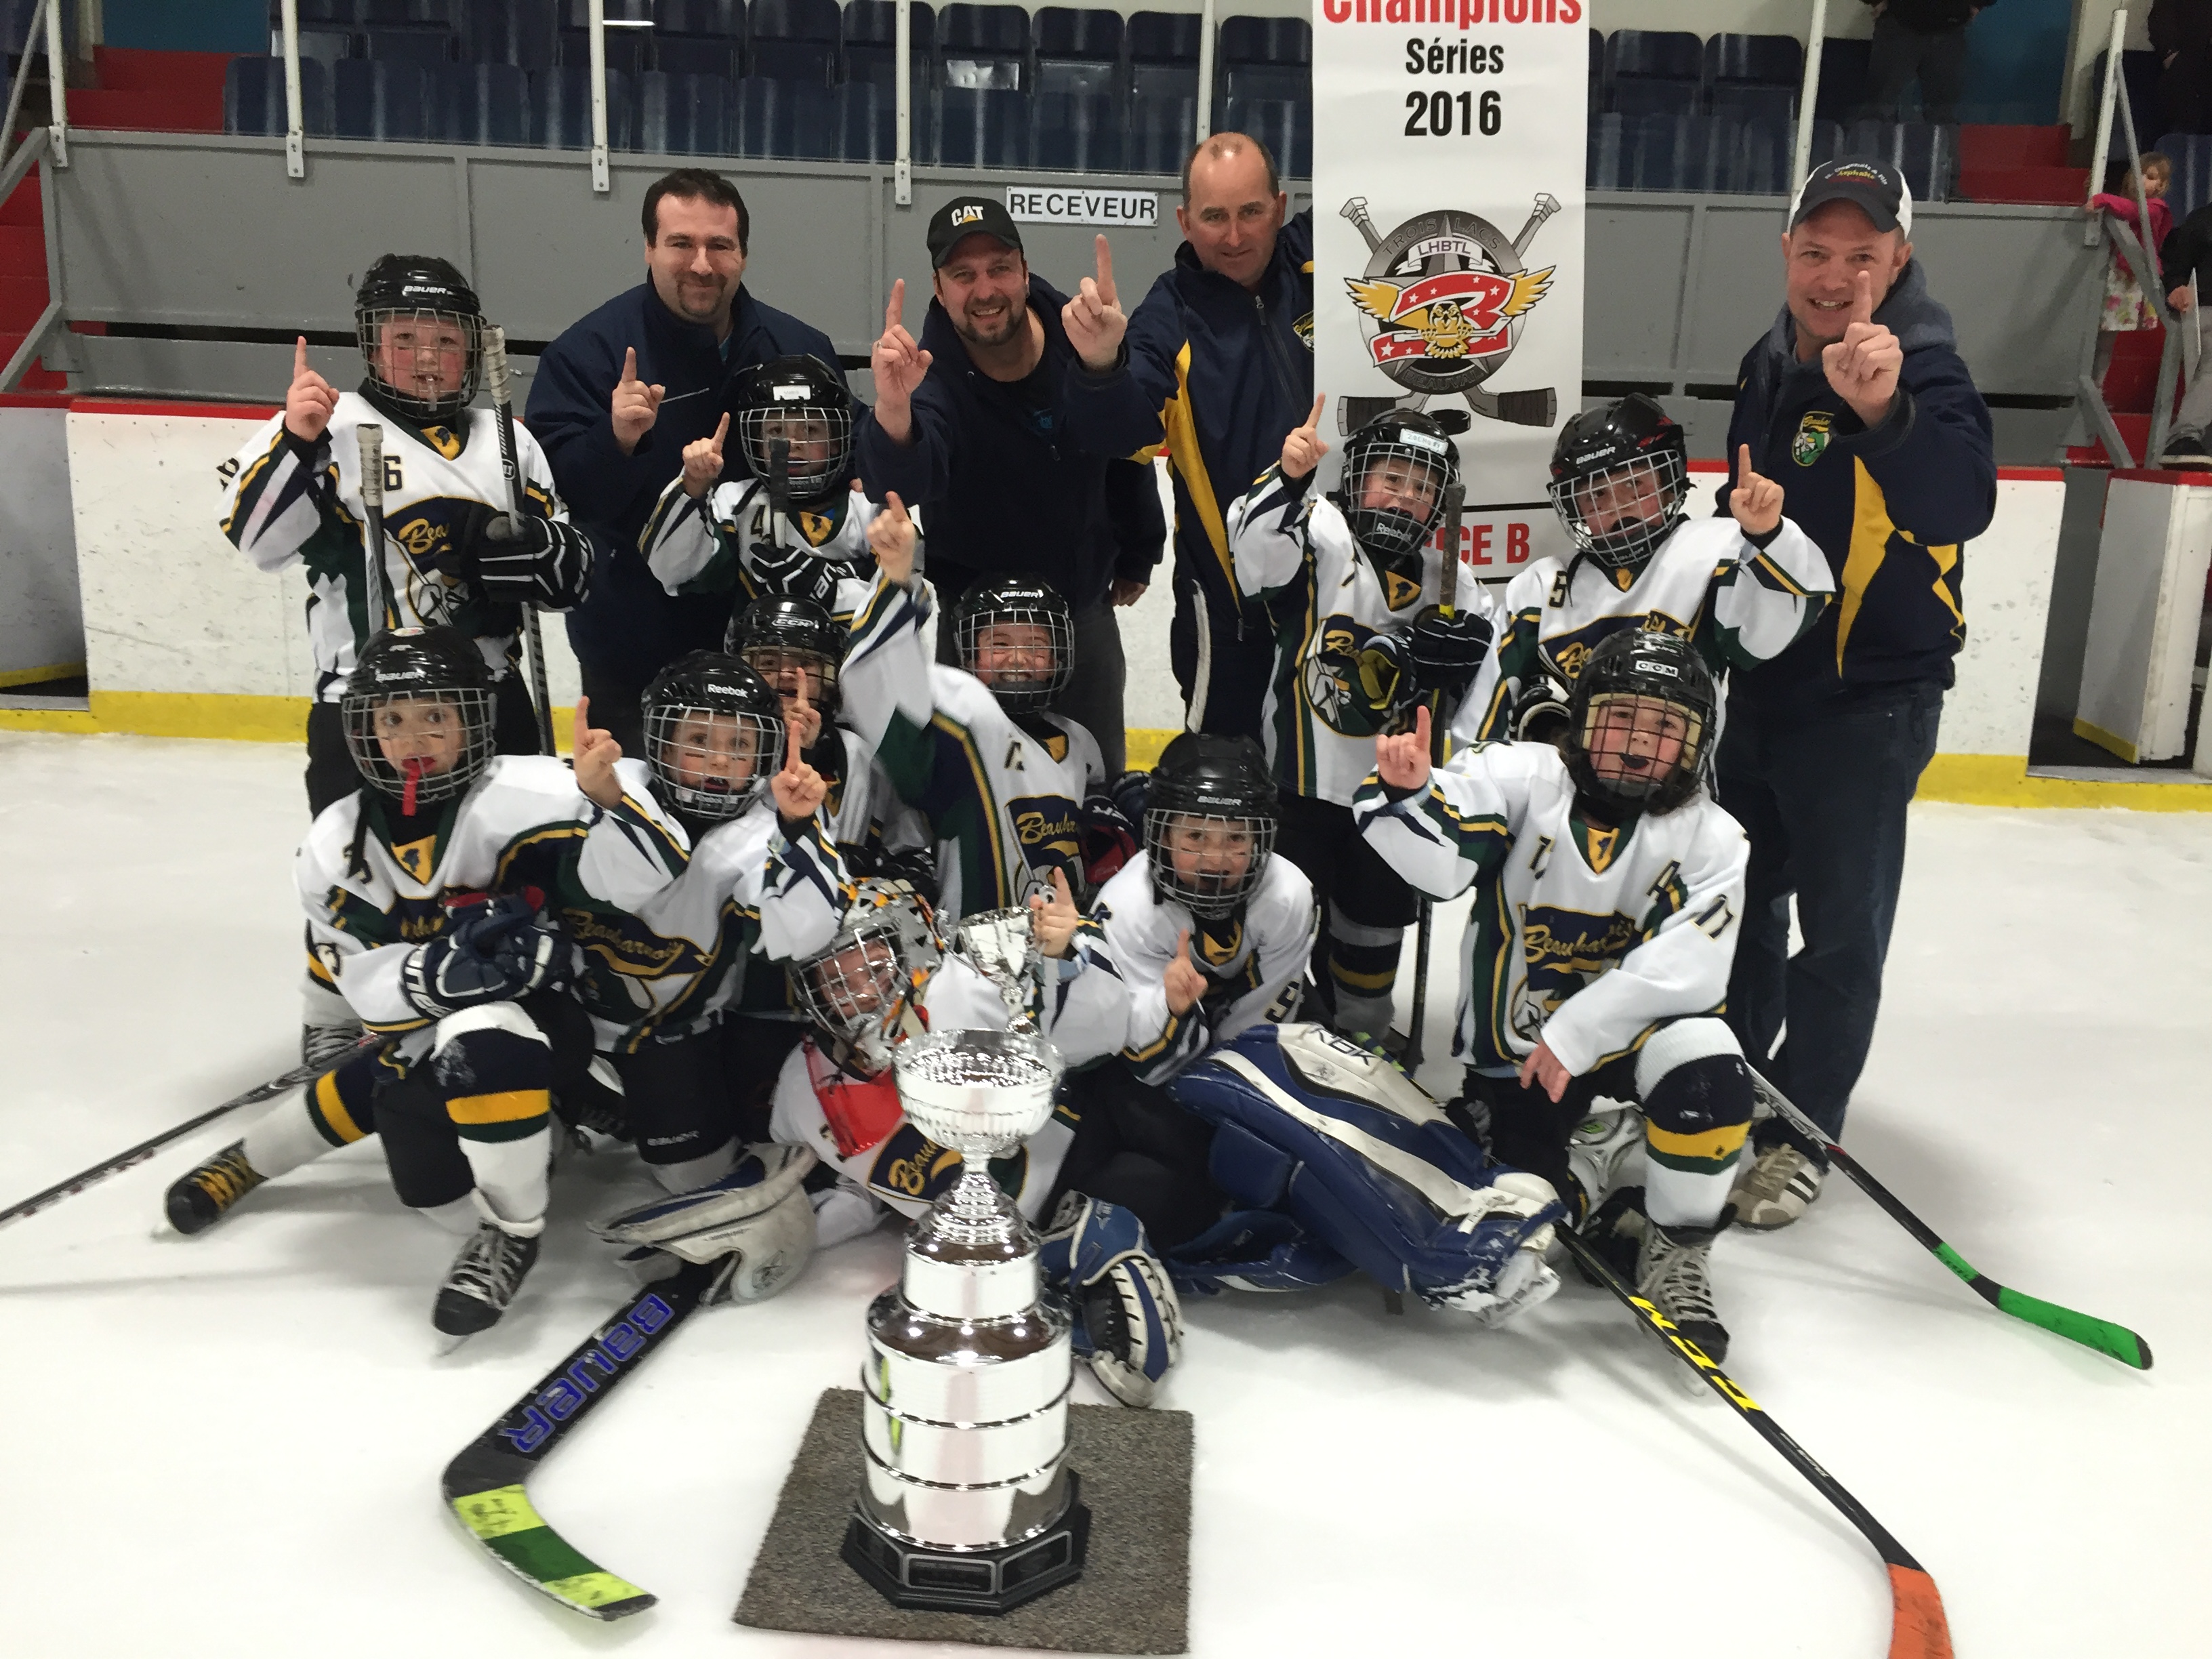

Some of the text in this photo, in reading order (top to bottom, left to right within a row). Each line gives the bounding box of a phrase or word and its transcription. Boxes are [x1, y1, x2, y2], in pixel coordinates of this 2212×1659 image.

[1406, 37, 1504, 75] Séries
[1404, 90, 1502, 137] 2016
[951, 205, 984, 227] CAT
[1010, 193, 1155, 220] RECEVEUR
[1382, 217, 1502, 255] TROIS LACS
[1417, 240, 1471, 256] LHBTL
[403, 285, 447, 294] BAUER
[1401, 369, 1483, 391] BEAUVAL
[1576, 446, 1616, 464] BAUER
[382, 454, 403, 493] 6
[1507, 523, 1530, 563] B
[775, 618, 811, 628] CCM
[1638, 662, 1676, 676] CCM
[708, 683, 748, 699] Reebok
[1197, 795, 1242, 807] BAUER
[1629, 1296, 1763, 1413] CCM
[497, 1293, 675, 1453] BAUER
